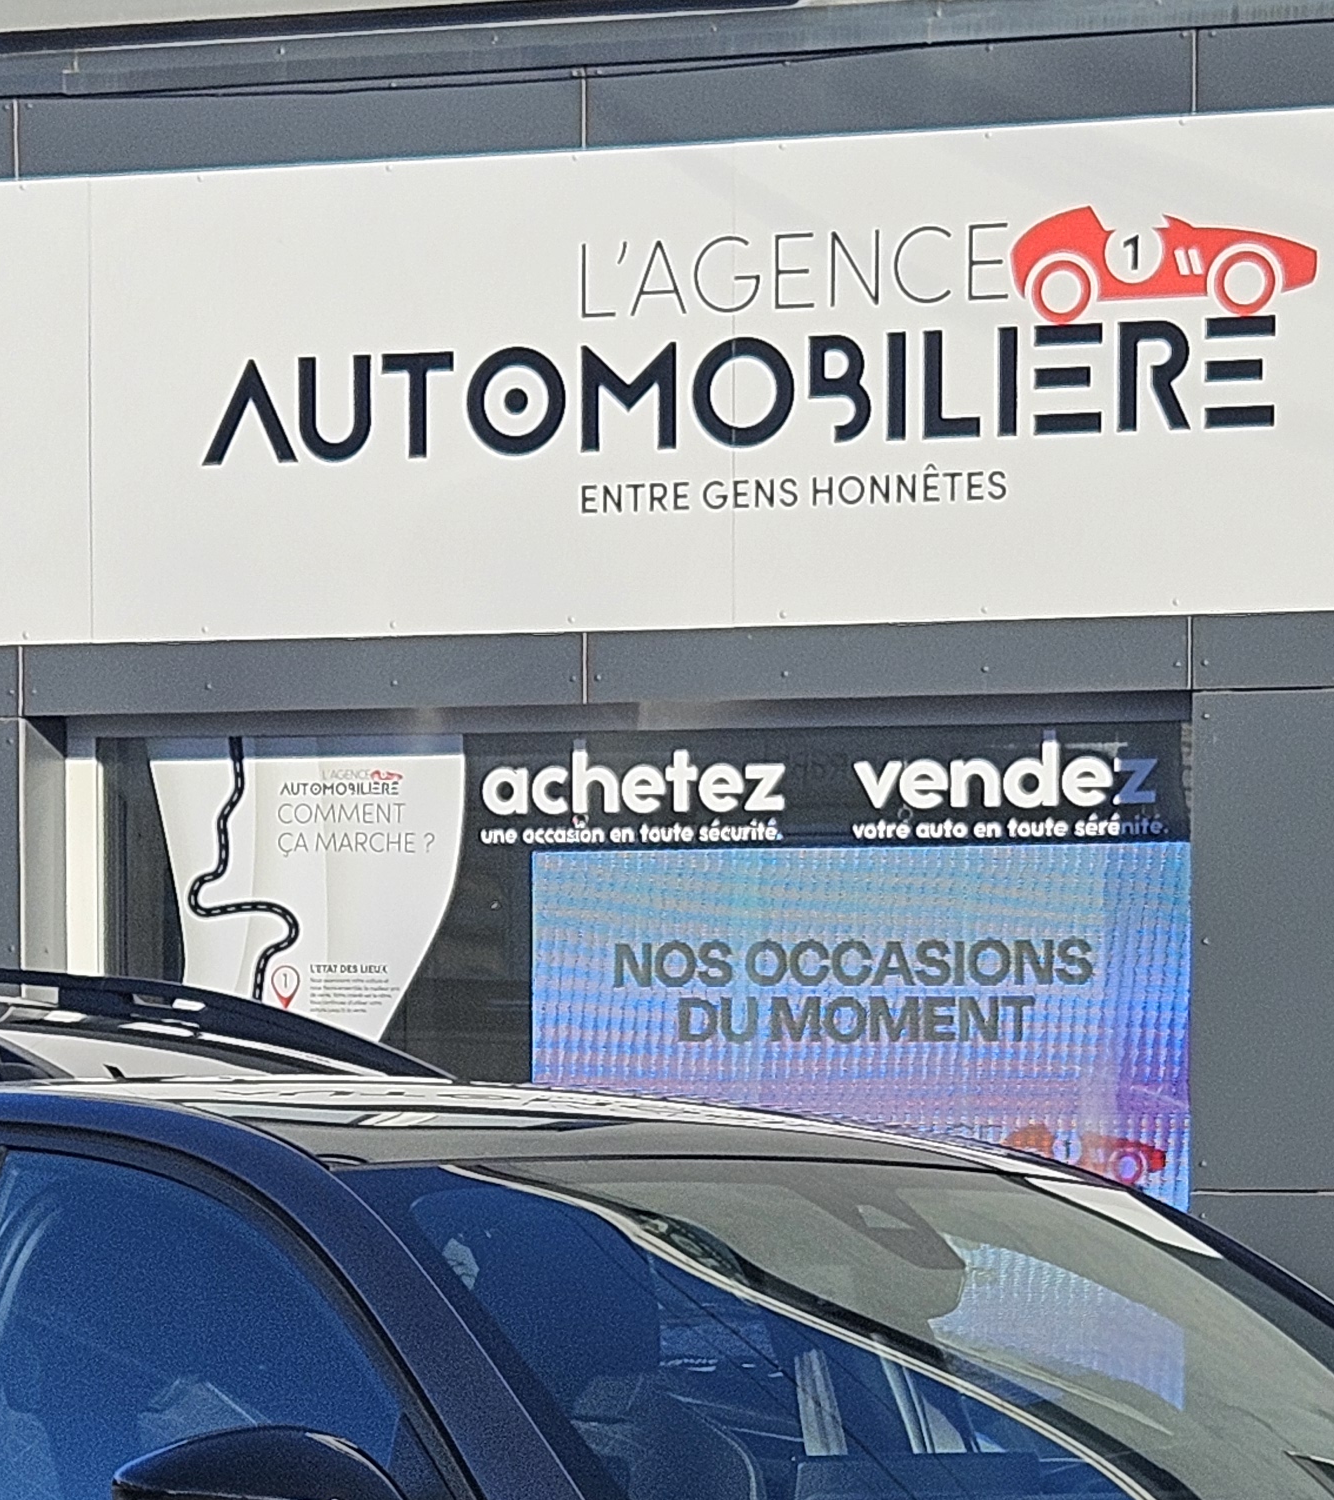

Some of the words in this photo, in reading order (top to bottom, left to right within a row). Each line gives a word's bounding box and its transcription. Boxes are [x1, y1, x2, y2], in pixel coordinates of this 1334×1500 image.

[580, 221, 1010, 319] L'AGENCE
[579, 480, 691, 515] ENTRE
[701, 477, 799, 511] GENS
[811, 462, 1008, 507] HONNÊTES
[481, 748, 786, 816] achetez
[852, 739, 1158, 810] vendez
[277, 802, 406, 824] COMMENT
[852, 817, 911, 840] votre
[915, 817, 968, 839] auto
[973, 821, 1002, 839] en
[1007, 816, 1069, 839] toute
[277, 831, 309, 858] ÇA
[314, 831, 417, 854] MARCHE
[423, 832, 436, 853] ?
[480, 827, 518, 845] une
[522, 823, 605, 844] occasion
[610, 827, 636, 843] en
[640, 822, 695, 843] toute
[339, 964, 359, 974] DES
[613, 939, 734, 989] NOS
[744, 936, 1096, 987] OCCASIONS
[678, 995, 760, 1043] DU
[769, 994, 1036, 1043] MOMENT
